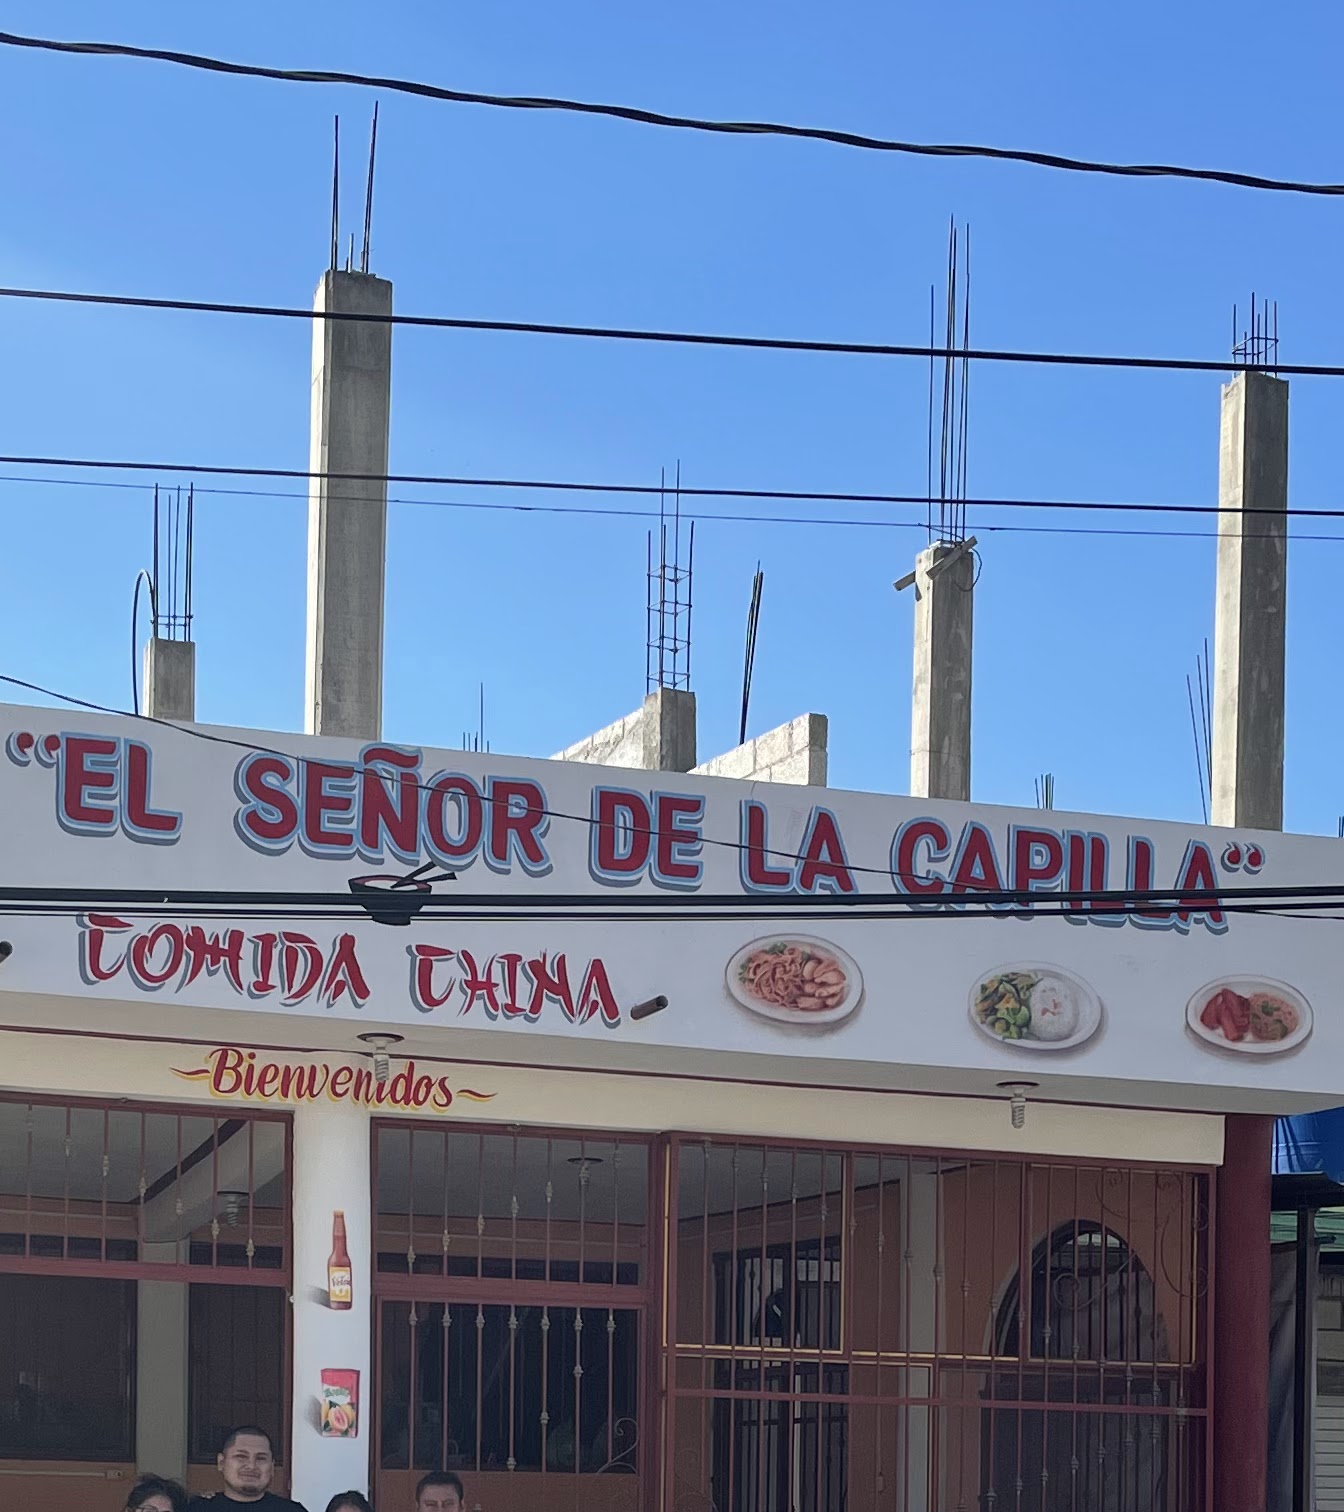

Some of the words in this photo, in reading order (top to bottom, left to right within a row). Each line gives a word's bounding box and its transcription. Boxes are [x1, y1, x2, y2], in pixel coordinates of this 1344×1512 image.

[235, 742, 550, 873] SEÑOR
[589, 785, 704, 887] DE
[740, 800, 857, 894] LA
[83, 913, 370, 1003] COMIDA
[409, 944, 620, 1025] CHINA
